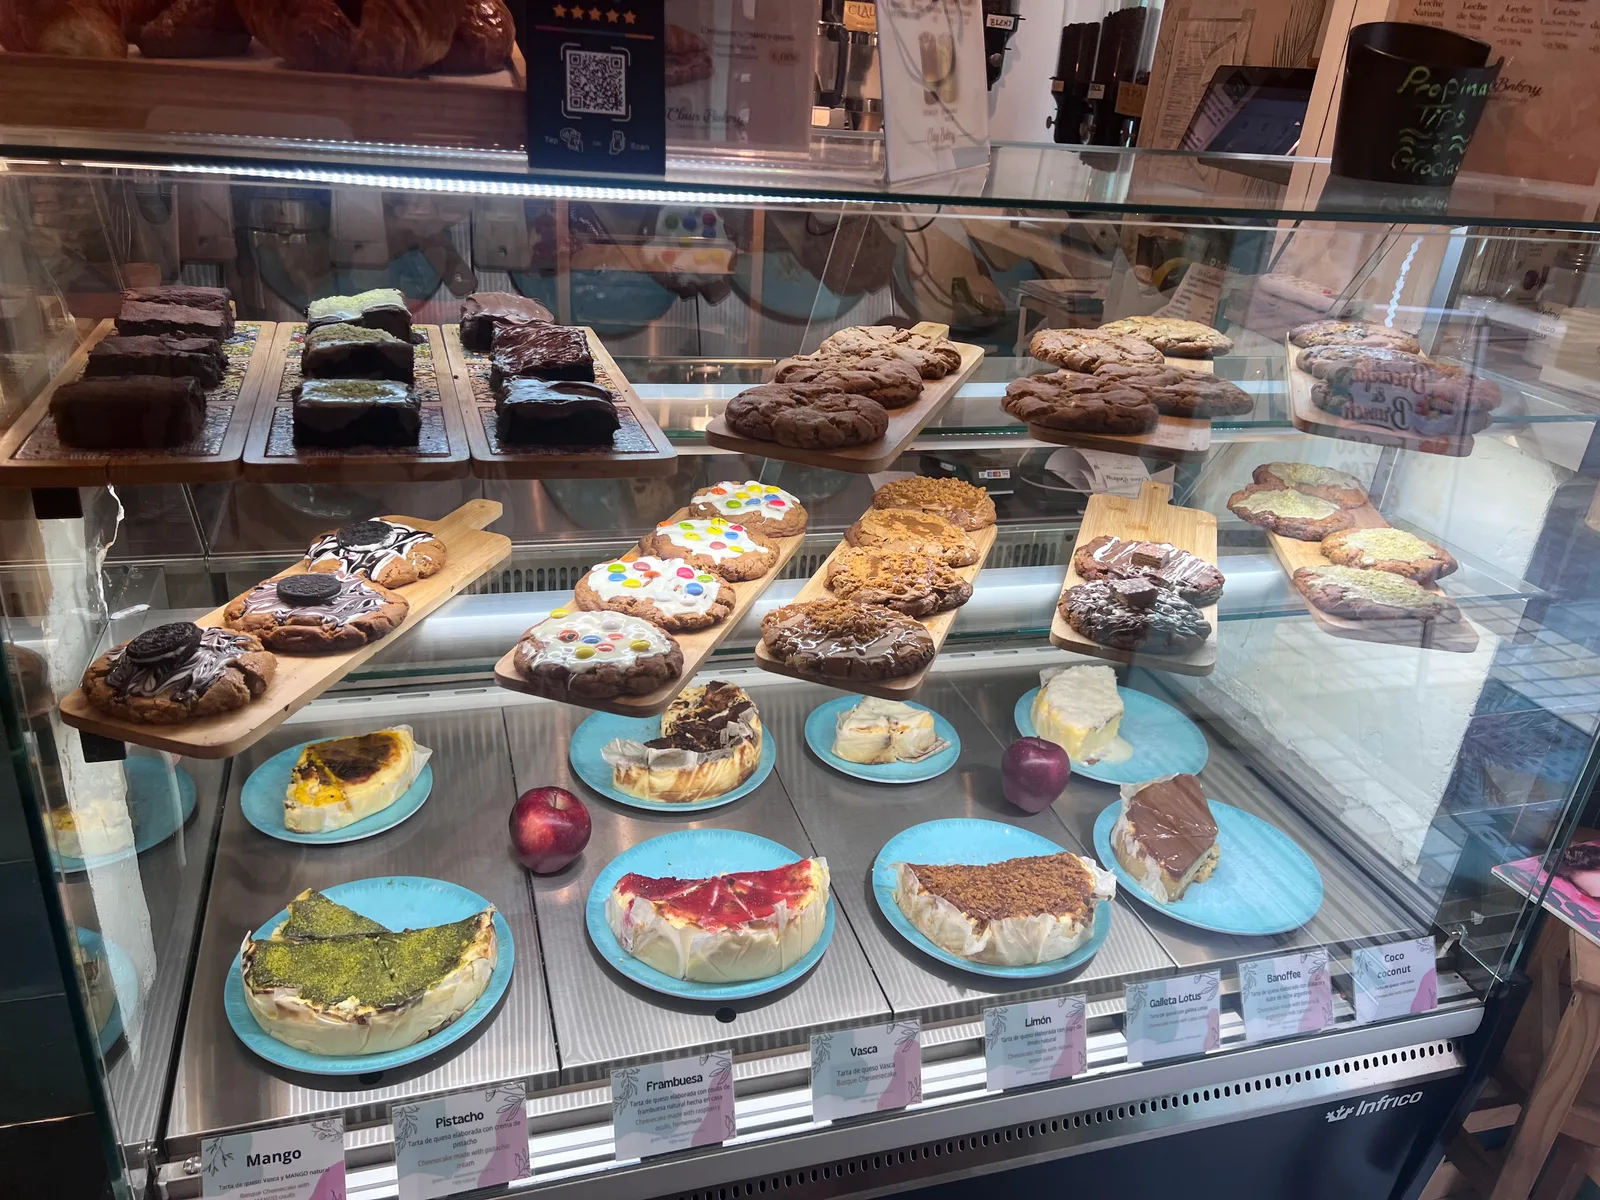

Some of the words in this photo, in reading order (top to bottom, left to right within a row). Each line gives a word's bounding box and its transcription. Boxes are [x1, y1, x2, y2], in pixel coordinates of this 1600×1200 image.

[1462, 2, 1488, 10] Leche
[1505, 4, 1532, 14] Leche
[1552, 7, 1580, 16] Leche
[1413, 8, 1445, 18] Natural
[1384, 953, 1404, 962] Coco
[1266, 970, 1302, 983] Banoffee
[1378, 965, 1411, 978] coconut
[1150, 997, 1176, 1008] Galleta
[1178, 992, 1202, 1004] Lotus
[1025, 1015, 1052, 1028] Limón
[850, 1046, 878, 1056] Vasca
[862, 1066, 878, 1074] queso
[646, 1074, 703, 1092] Frambuesa
[836, 1078, 857, 1088] Basque
[653, 1096, 669, 1104] queso
[670, 1090, 696, 1101] elaborada
[638, 1106, 666, 1116] frambuesa
[666, 1101, 686, 1110] natural
[686, 1098, 702, 1106] hecha
[1356, 1092, 1423, 1116] Infrico
[436, 1112, 484, 1128] Pistacho
[636, 1114, 666, 1126] Cheesecake
[667, 1112, 682, 1120] made
[408, 1140, 423, 1148] Tarta
[434, 1134, 452, 1144] queso
[452, 1128, 481, 1138] elaborada
[494, 1123, 512, 1131] crema
[452, 1138, 478, 1149] pistacho
[246, 1149, 302, 1168] Mango
[418, 1154, 452, 1167] Cheesecake
[454, 1151, 470, 1160] made
[472, 1148, 484, 1156] with
[456, 1161, 474, 1170] cream
[285, 1170, 308, 1179] MANGO
[309, 1167, 330, 1175] natural
[240, 1190, 261, 1199] Basque
